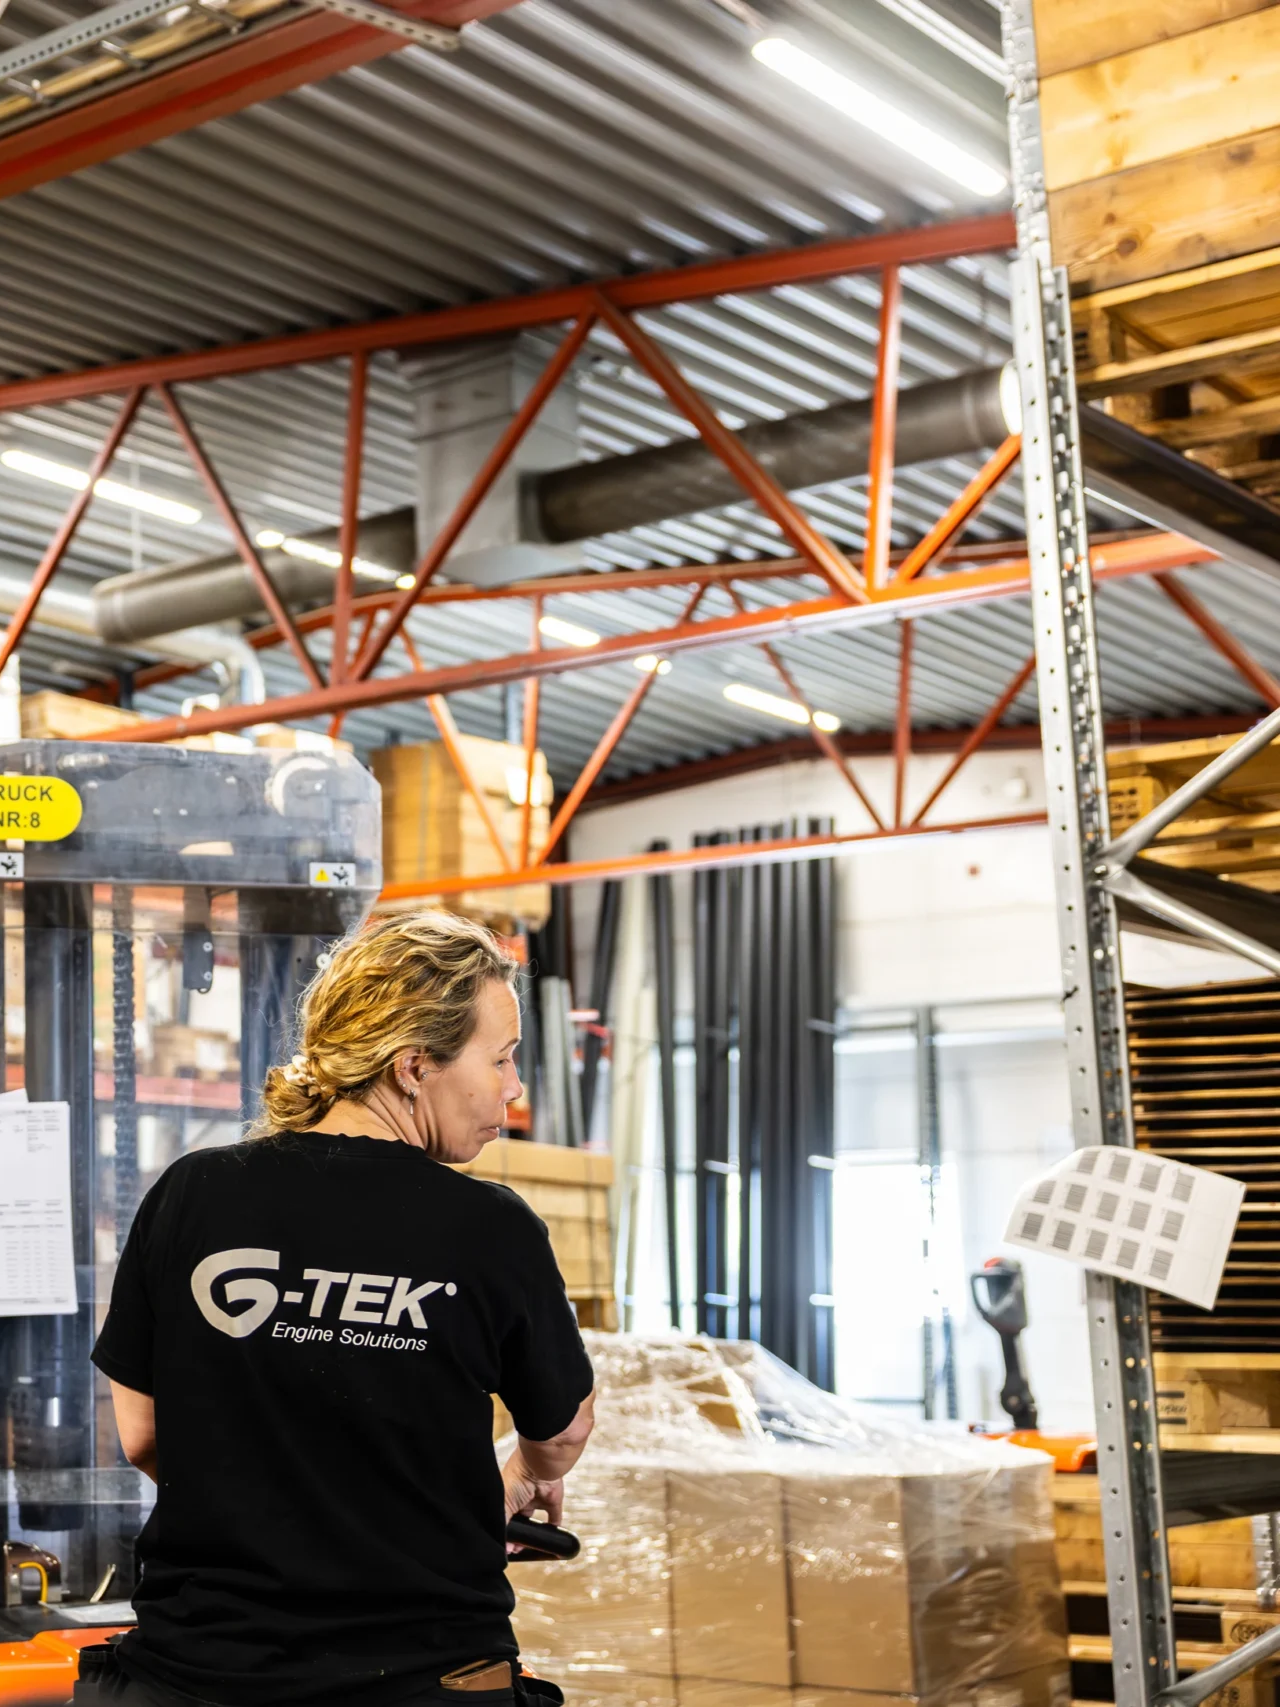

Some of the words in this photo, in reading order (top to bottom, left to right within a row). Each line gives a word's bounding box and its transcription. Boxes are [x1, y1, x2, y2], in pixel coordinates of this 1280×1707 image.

[190, 1247, 446, 1338] G-TEK
[271, 1321, 334, 1343] Engine
[339, 1328, 428, 1351] Solutions
